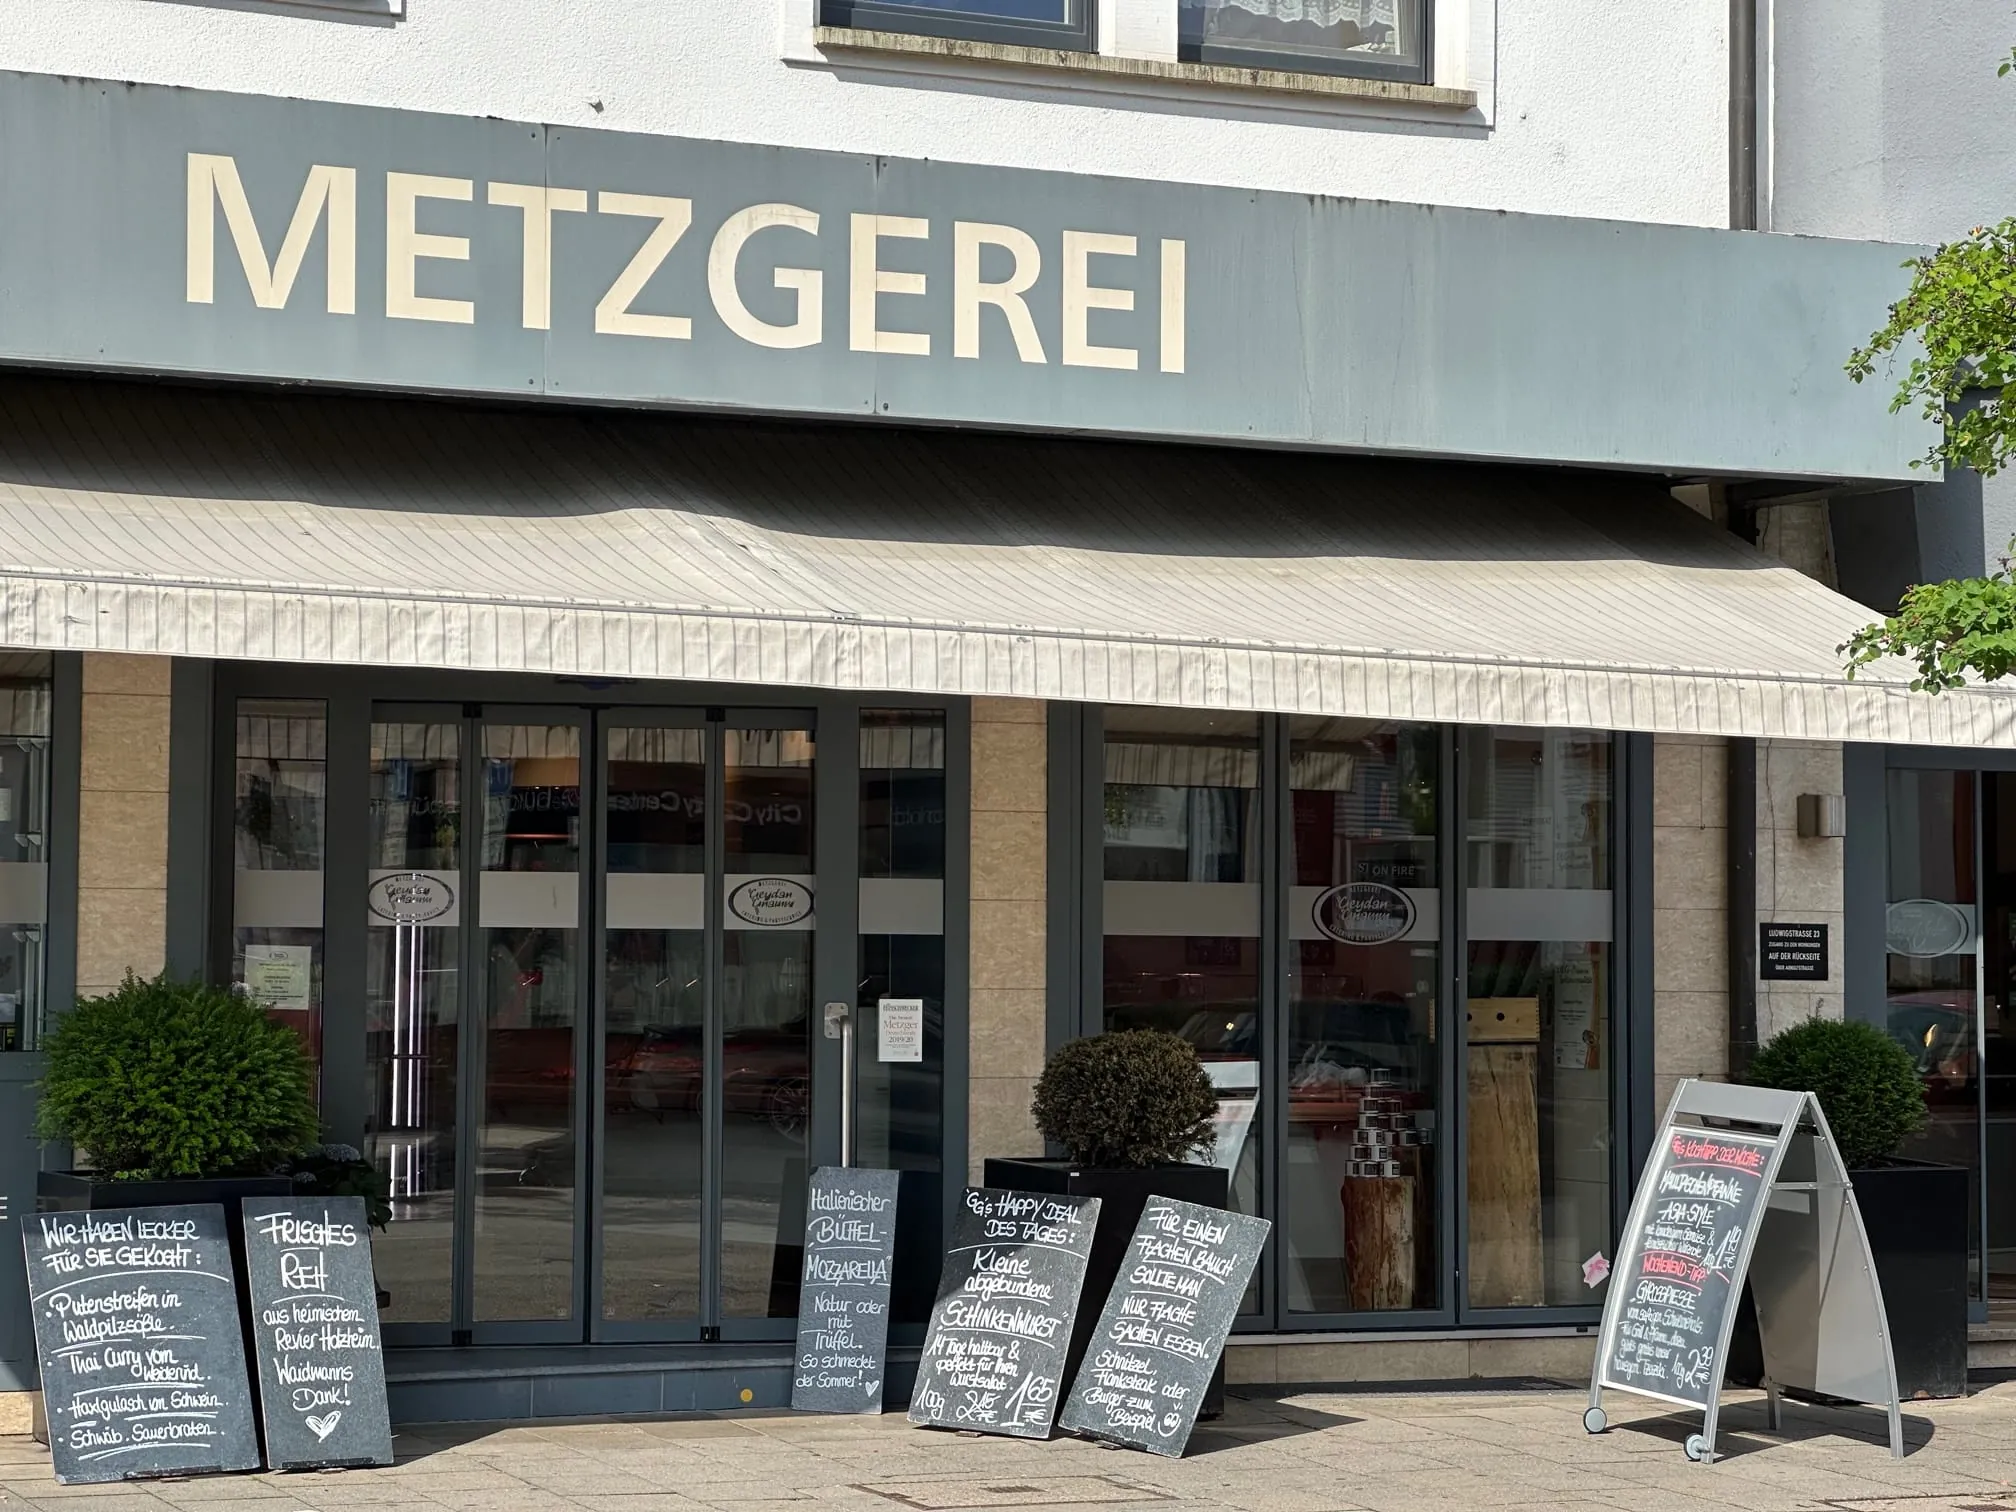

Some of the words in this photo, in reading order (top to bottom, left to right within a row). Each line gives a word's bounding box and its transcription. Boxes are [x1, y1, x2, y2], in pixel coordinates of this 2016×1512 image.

[186, 152, 1185, 373] METZGEREI
[1372, 863, 1389, 877] ON
[1391, 864, 1416, 877] FIRE
[1768, 952, 1780, 960] AUF
[1780, 952, 1791, 960] DER
[1792, 951, 1820, 961] RÜCKSEITE
[884, 1019, 918, 1031] Metzger
[994, 1192, 1046, 1221] HAPPY
[1042, 1202, 1081, 1224] DEAL
[41, 1218, 81, 1248] WIR
[79, 1214, 134, 1243] HABEN
[138, 1220, 200, 1240] LECKER
[254, 1210, 357, 1247] FRISCHES
[984, 1219, 1017, 1238] DES
[1149, 1207, 1181, 1233] FÜR
[1182, 1219, 1230, 1245] EINEN
[1707, 1231, 1716, 1246] &
[42, 1249, 84, 1274] FÜR
[85, 1248, 115, 1267] SIE
[972, 1248, 1032, 1275] Kleine
[1136, 1235, 1195, 1265] FLACHEN
[280, 1252, 328, 1292] REH
[1129, 1265, 1177, 1291] SOLLTE
[1175, 1275, 1206, 1298] MAN
[964, 1273, 1055, 1301] abgebundene
[49, 1285, 158, 1318] Putenstreifen
[161, 1290, 181, 1309] im
[815, 1292, 852, 1313] Natur
[856, 1300, 886, 1314] oder
[1120, 1295, 1149, 1317] NUR
[1150, 1302, 1197, 1326] FLACHE
[263, 1309, 289, 1326] aus
[827, 1315, 853, 1329] mit
[275, 1327, 318, 1351] Revier
[927, 1333, 945, 1356] 14
[943, 1338, 968, 1359] Tage
[1007, 1340, 1021, 1361] &
[1109, 1321, 1164, 1346] SACHEN
[58, 1351, 102, 1375] Thai
[104, 1347, 142, 1377] Curry
[145, 1349, 179, 1364] vom
[273, 1355, 353, 1385] Waidmanns
[799, 1354, 818, 1369] So
[821, 1354, 876, 1369] schmeckt
[796, 1373, 817, 1388] der
[1092, 1368, 1158, 1394] Flanksteak
[1161, 1382, 1191, 1400] oder
[292, 1384, 351, 1411] Dank!
[1082, 1387, 1126, 1415] Burger
[1125, 1396, 1154, 1412] zum
